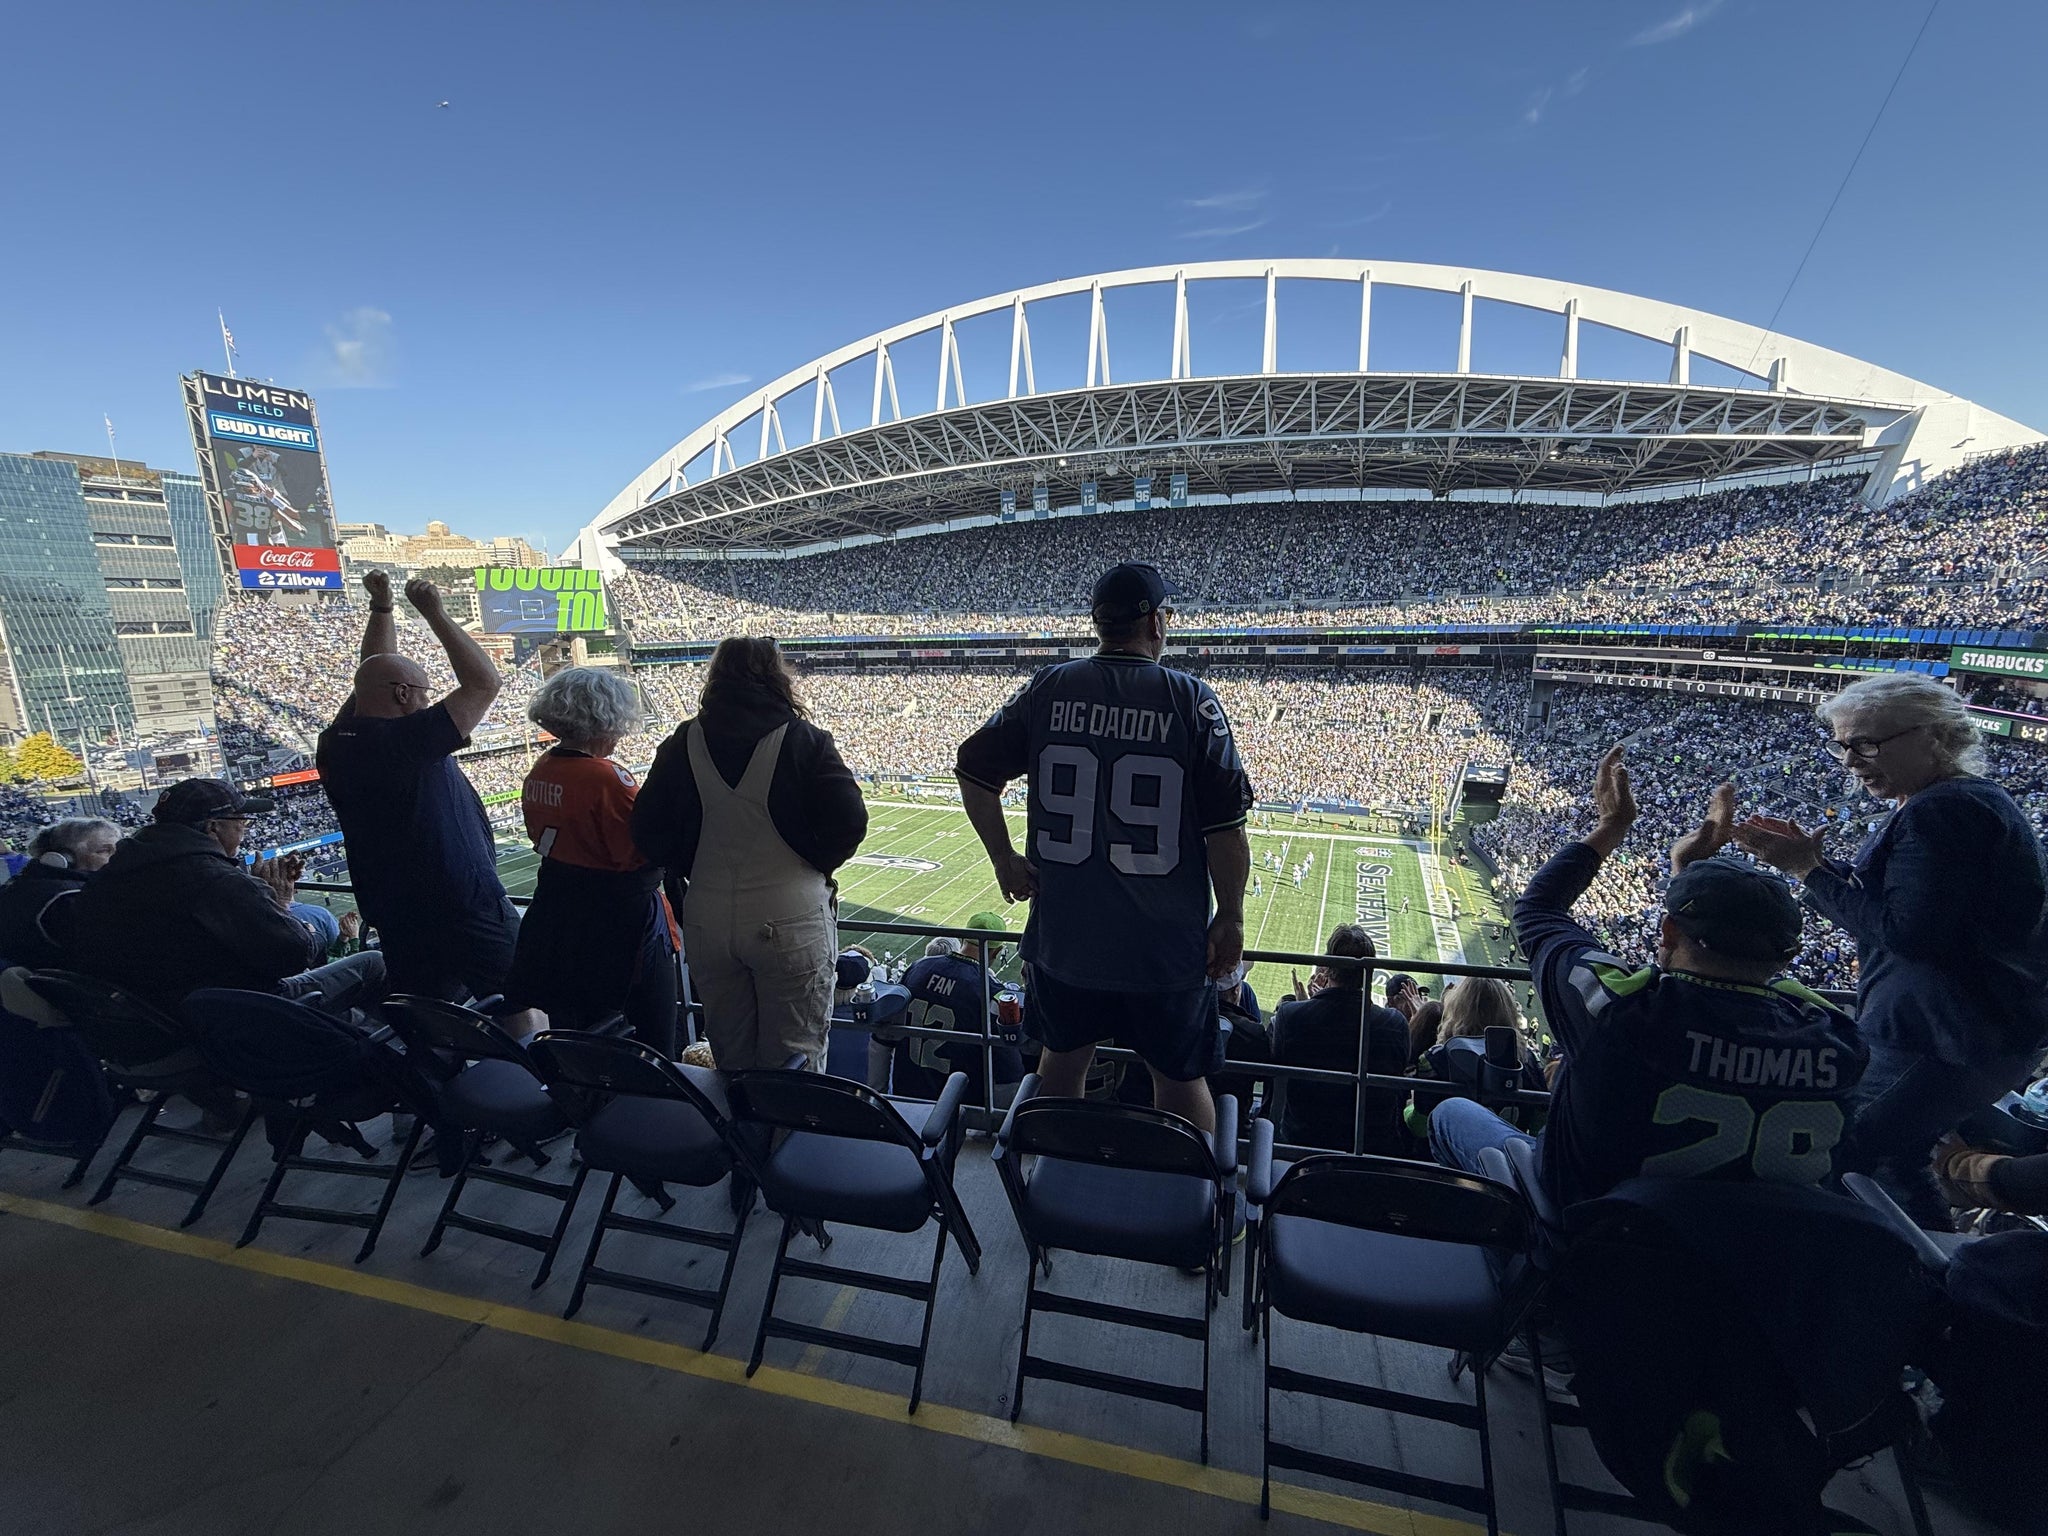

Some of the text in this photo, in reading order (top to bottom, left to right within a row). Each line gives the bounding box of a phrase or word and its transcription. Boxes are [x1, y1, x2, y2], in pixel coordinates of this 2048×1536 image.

[202, 377, 310, 410] LUMEN
[238, 402, 284, 418] FIELD
[215, 418, 311, 444] BUD LIGHT
[1083, 495, 1095, 506] 12
[1136, 490, 1149, 502] 96
[1172, 487, 1185, 500] 71
[234, 500, 270, 530] 38
[1002, 503, 1014, 514] 45
[1034, 500, 1047, 511] 80
[260, 550, 316, 568] Coca-Cola
[274, 573, 326, 586] Zillow
[1961, 652, 2044, 672] STARBUCKS
[1594, 676, 1673, 690] WELCOME
[1686, 682, 1706, 692] TO
[1719, 685, 1781, 700] LUMEN
[1050, 701, 1174, 743] BIG DADDY
[1037, 744, 1184, 875] 99
[894, 904, 926, 914] 40
[926, 974, 956, 996] FAN
[855, 1011, 867, 1020] 11
[907, 998, 956, 1074] 12
[1686, 1030, 1838, 1088] THOMAS
